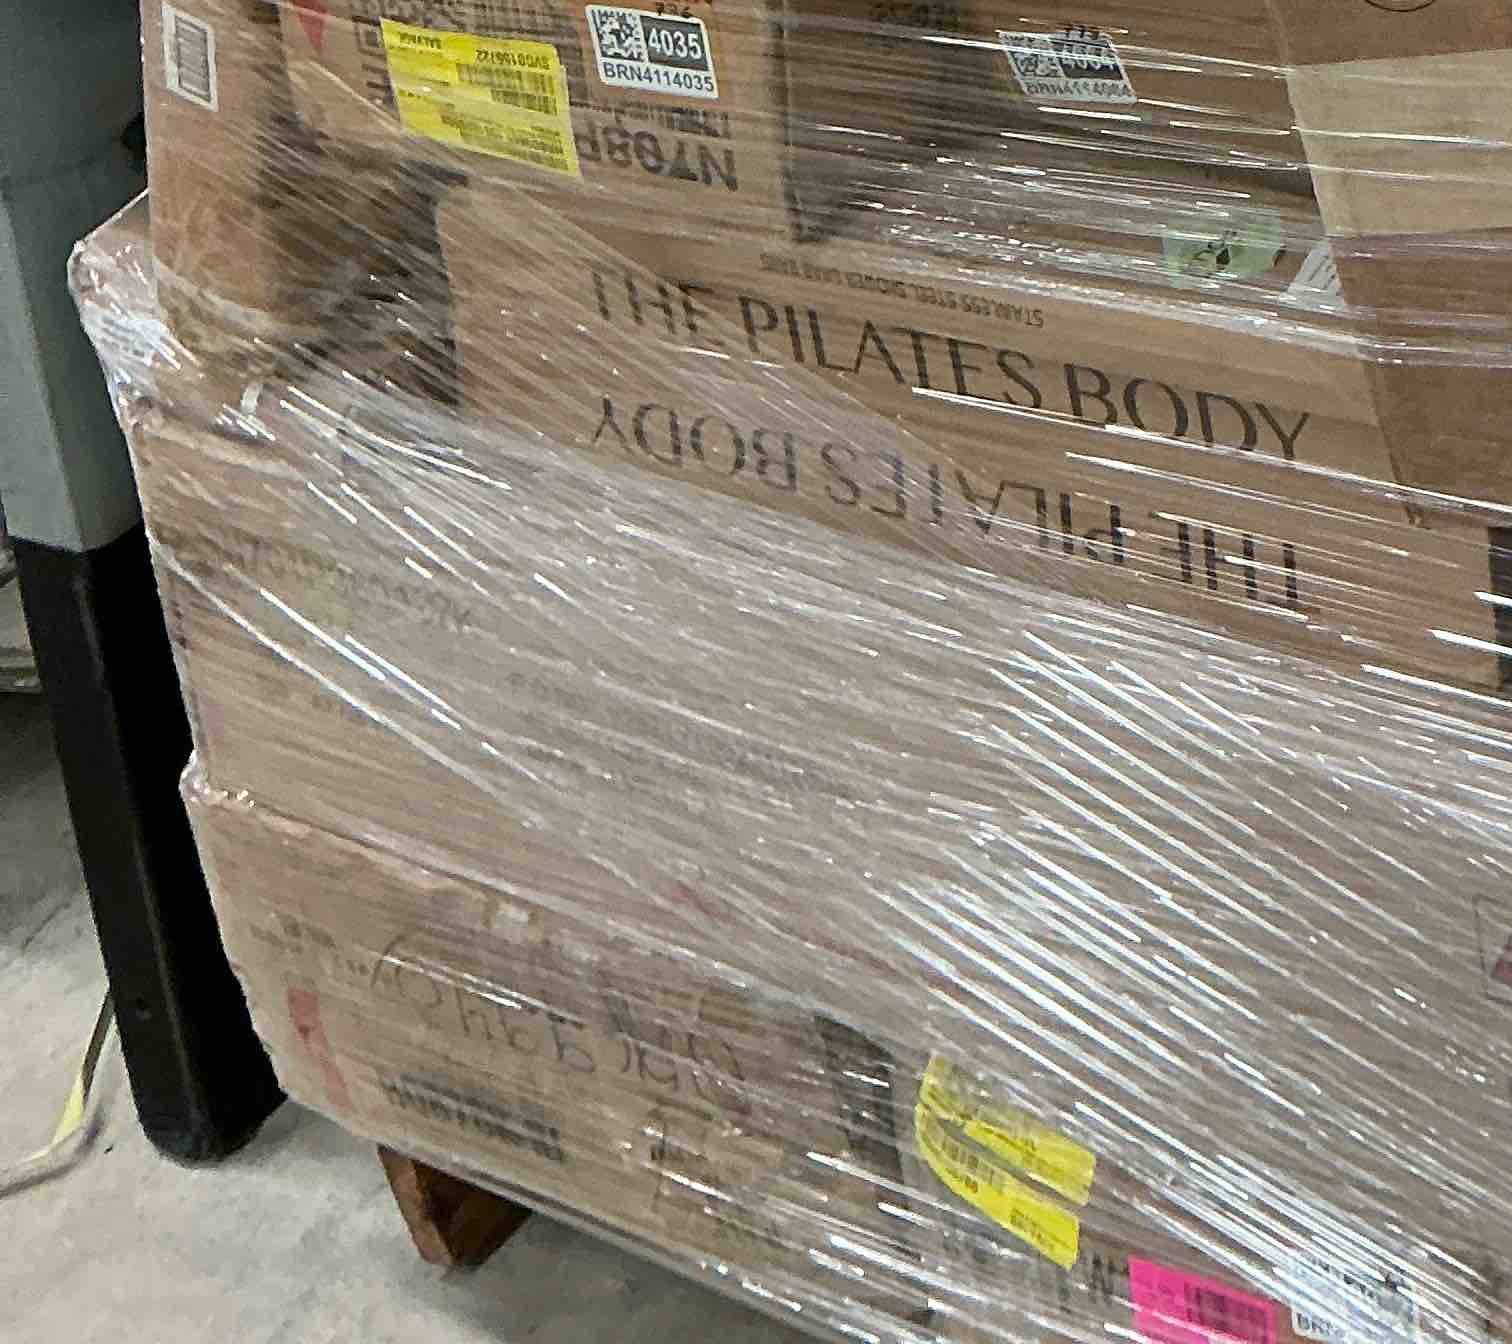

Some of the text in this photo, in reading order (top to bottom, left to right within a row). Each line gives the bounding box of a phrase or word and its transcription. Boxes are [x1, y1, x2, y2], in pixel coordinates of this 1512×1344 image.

[647, 25, 704, 61] 4035
[602, 60, 716, 94] BRN4114035
[736, 294, 1045, 411] PILATES
[1063, 362, 1312, 462] BODY
[592, 397, 796, 492] BODY
